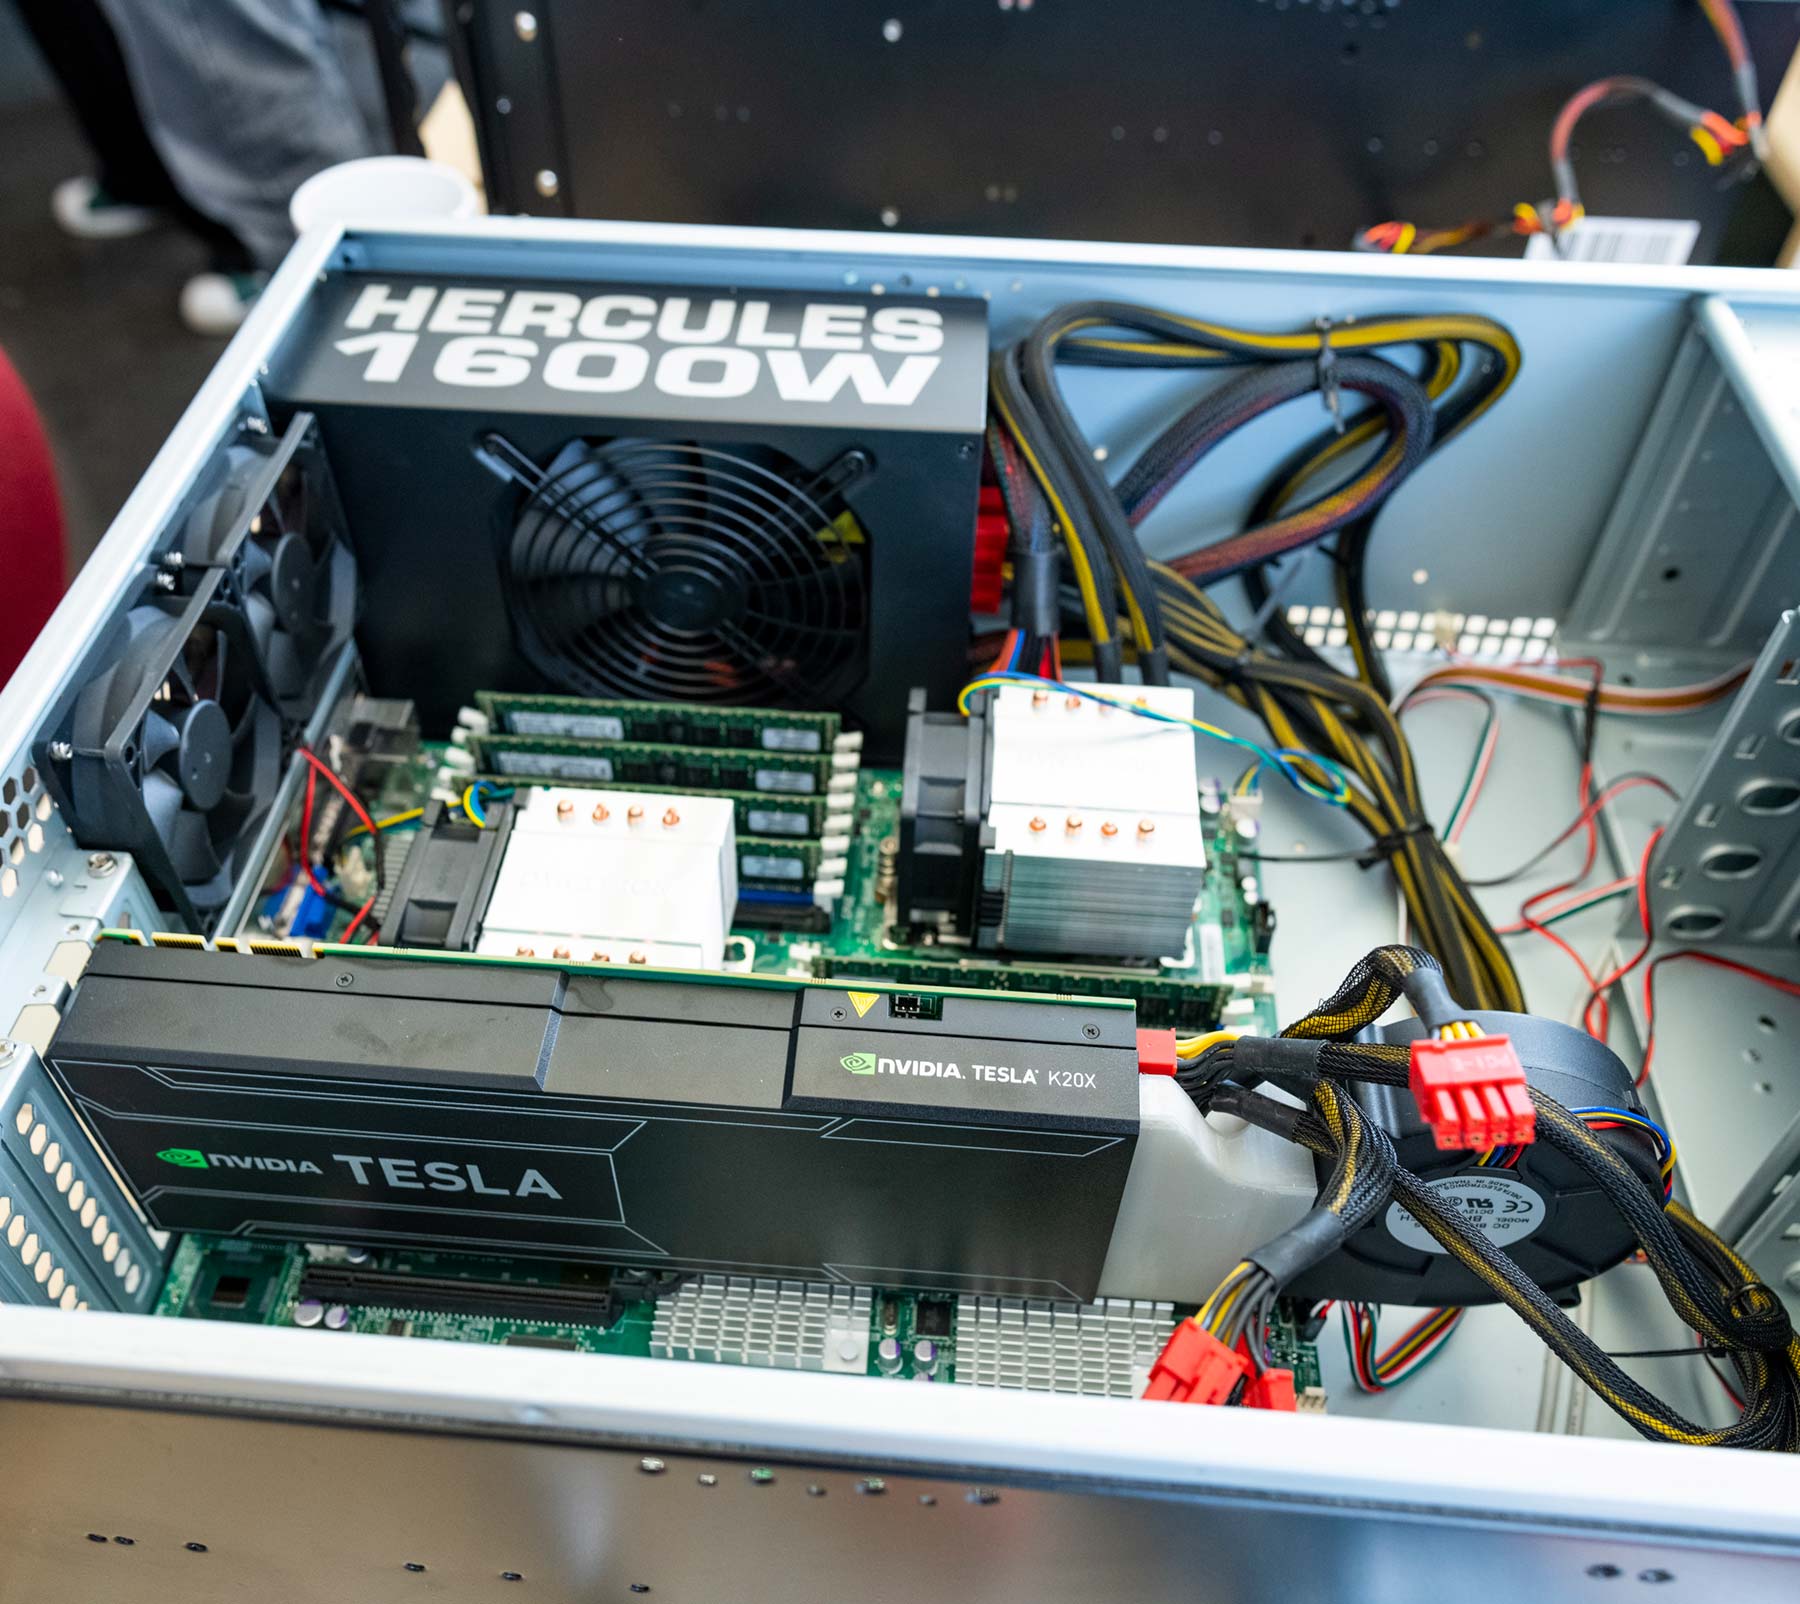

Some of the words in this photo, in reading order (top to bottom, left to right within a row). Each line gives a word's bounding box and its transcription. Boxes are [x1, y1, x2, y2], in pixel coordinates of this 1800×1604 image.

[344, 284, 944, 353] HERCULES
[333, 331, 942, 406] 1600W
[972, 1064, 1039, 1085] TESLA
[1048, 1070, 1097, 1089] K20X
[332, 1153, 563, 1200] TESLA
[1488, 1180, 1511, 1189] MADE
